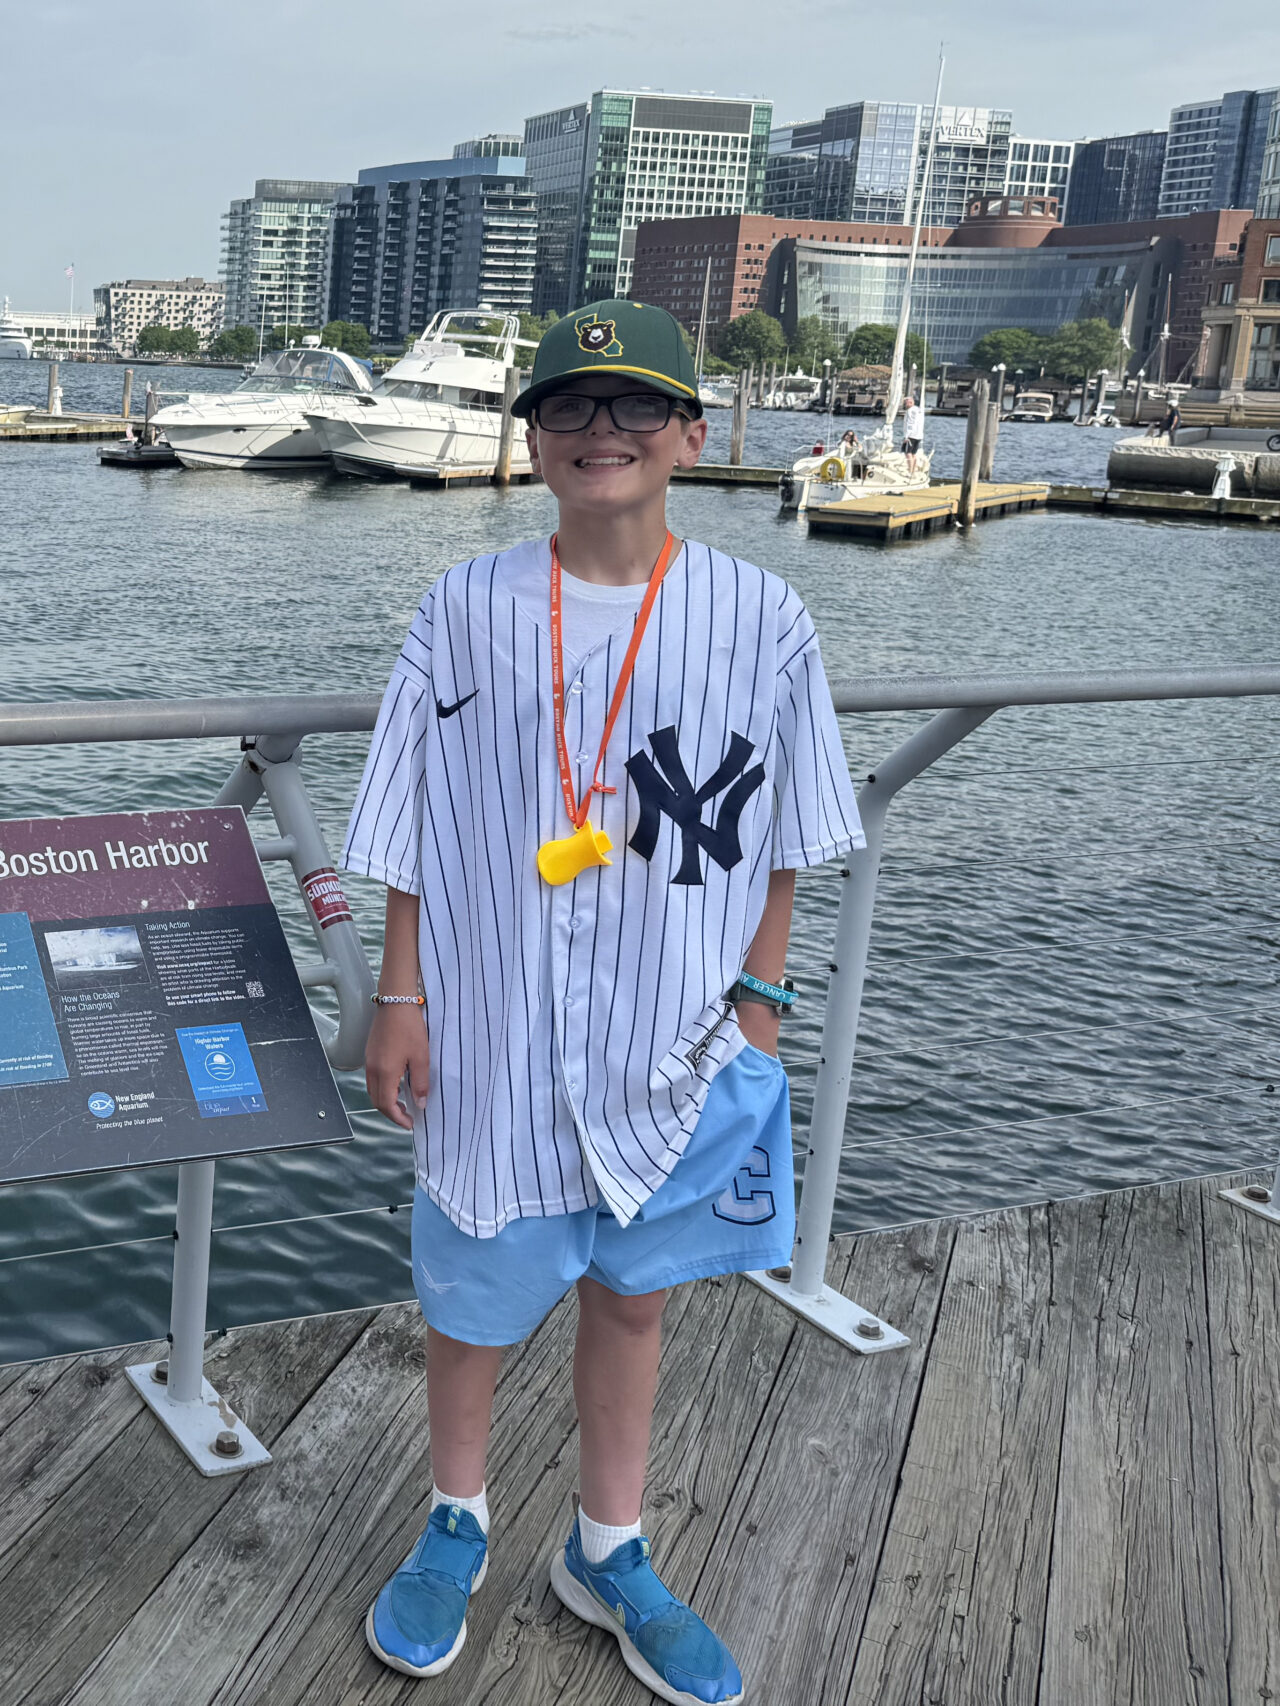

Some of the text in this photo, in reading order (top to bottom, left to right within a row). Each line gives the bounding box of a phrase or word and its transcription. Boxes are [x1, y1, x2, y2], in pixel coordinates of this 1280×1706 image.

[940, 125, 986, 138] VERTEX
[624, 724, 766, 886] NY
[105, 838, 209, 869] Harbor
[93, 991, 120, 1000] Oceans
[753, 981, 786, 1000] CANCER
[78, 1002, 112, 1011] Changing
[130, 1092, 155, 1101] England
[118, 1102, 149, 1112] Aquarium
[96, 1121, 122, 1129] Protecting
